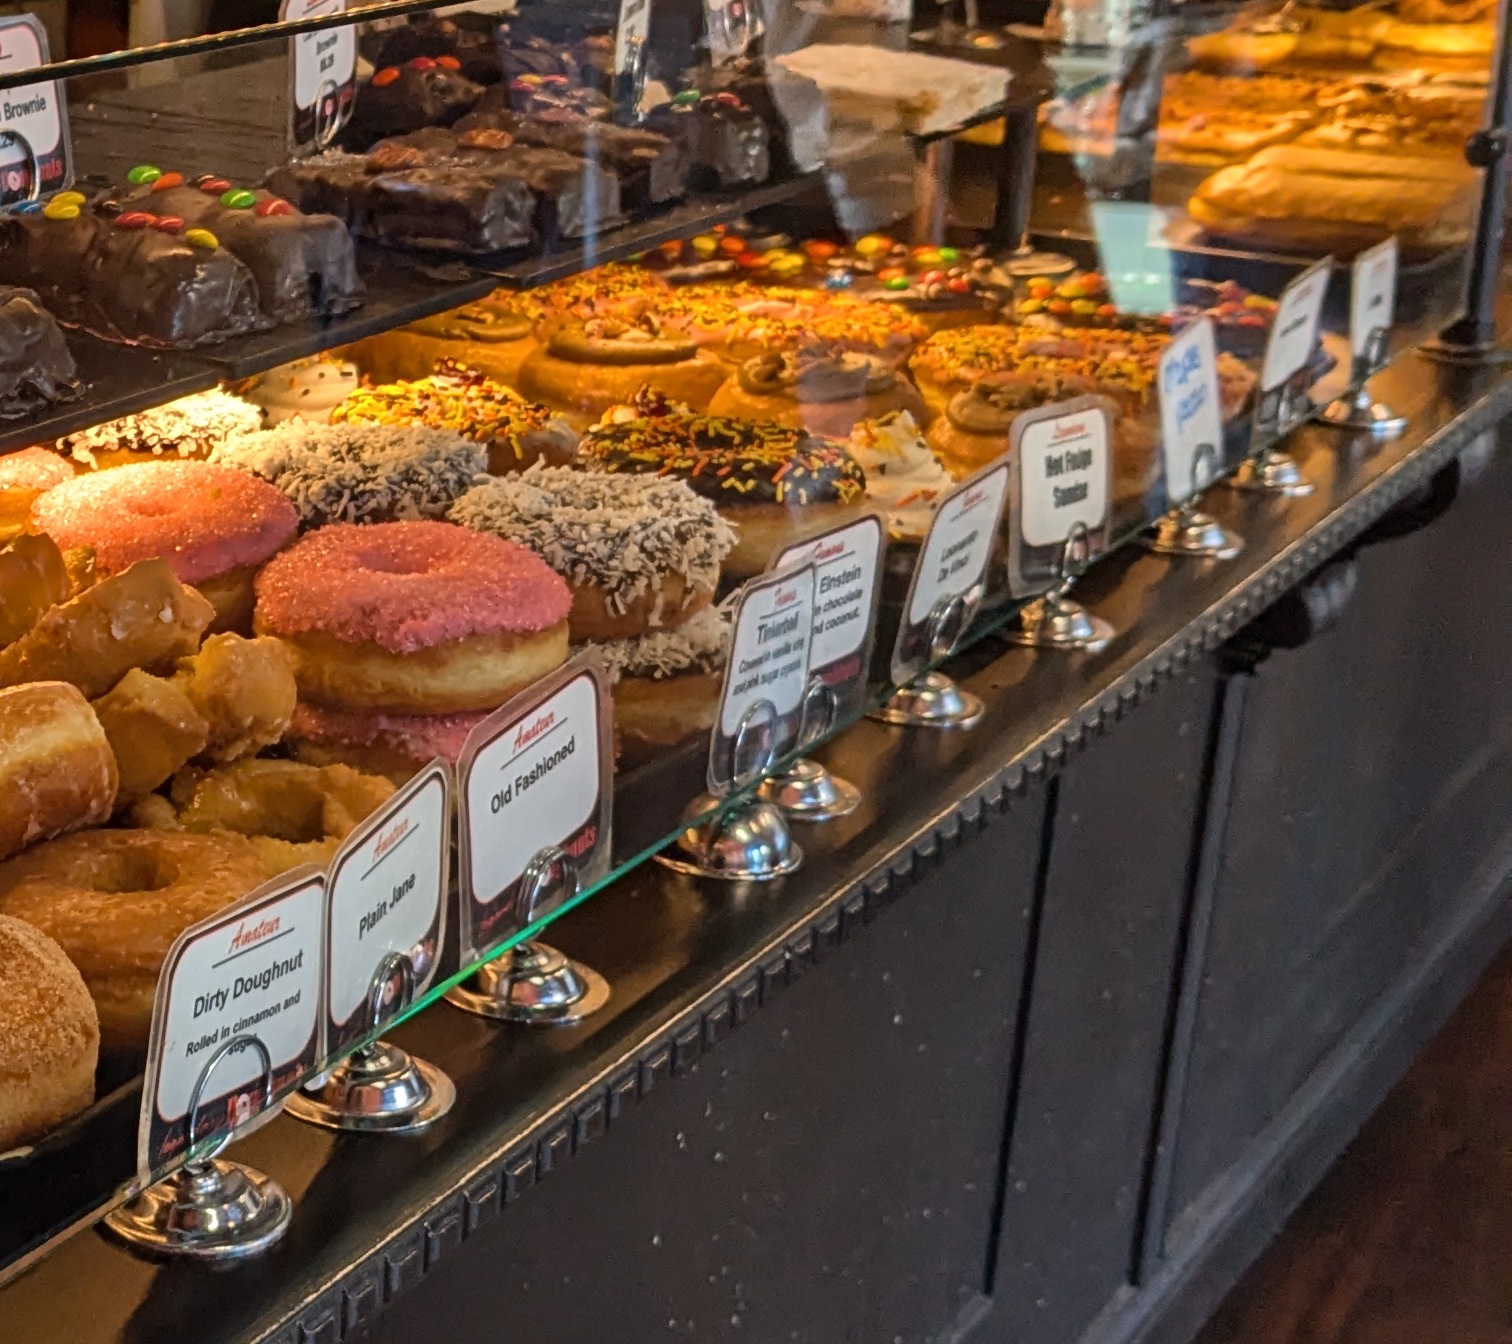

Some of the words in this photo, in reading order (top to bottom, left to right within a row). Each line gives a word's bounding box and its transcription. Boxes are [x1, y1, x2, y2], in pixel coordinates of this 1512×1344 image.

[3, 94, 47, 127] Brownie
[819, 564, 862, 594] Einstein
[490, 785, 513, 815] Old
[514, 735, 576, 792] Fashioned
[228, 916, 281, 954] Amateur
[358, 895, 388, 941] Plain
[389, 871, 417, 910] Jane
[192, 986, 230, 1019] Dirty
[232, 949, 304, 1001] Doughnut
[185, 1027, 219, 1058] Rolled
[220, 1023, 231, 1040] in
[232, 1000, 282, 1035] cinnamon
[283, 988, 301, 1015] and
